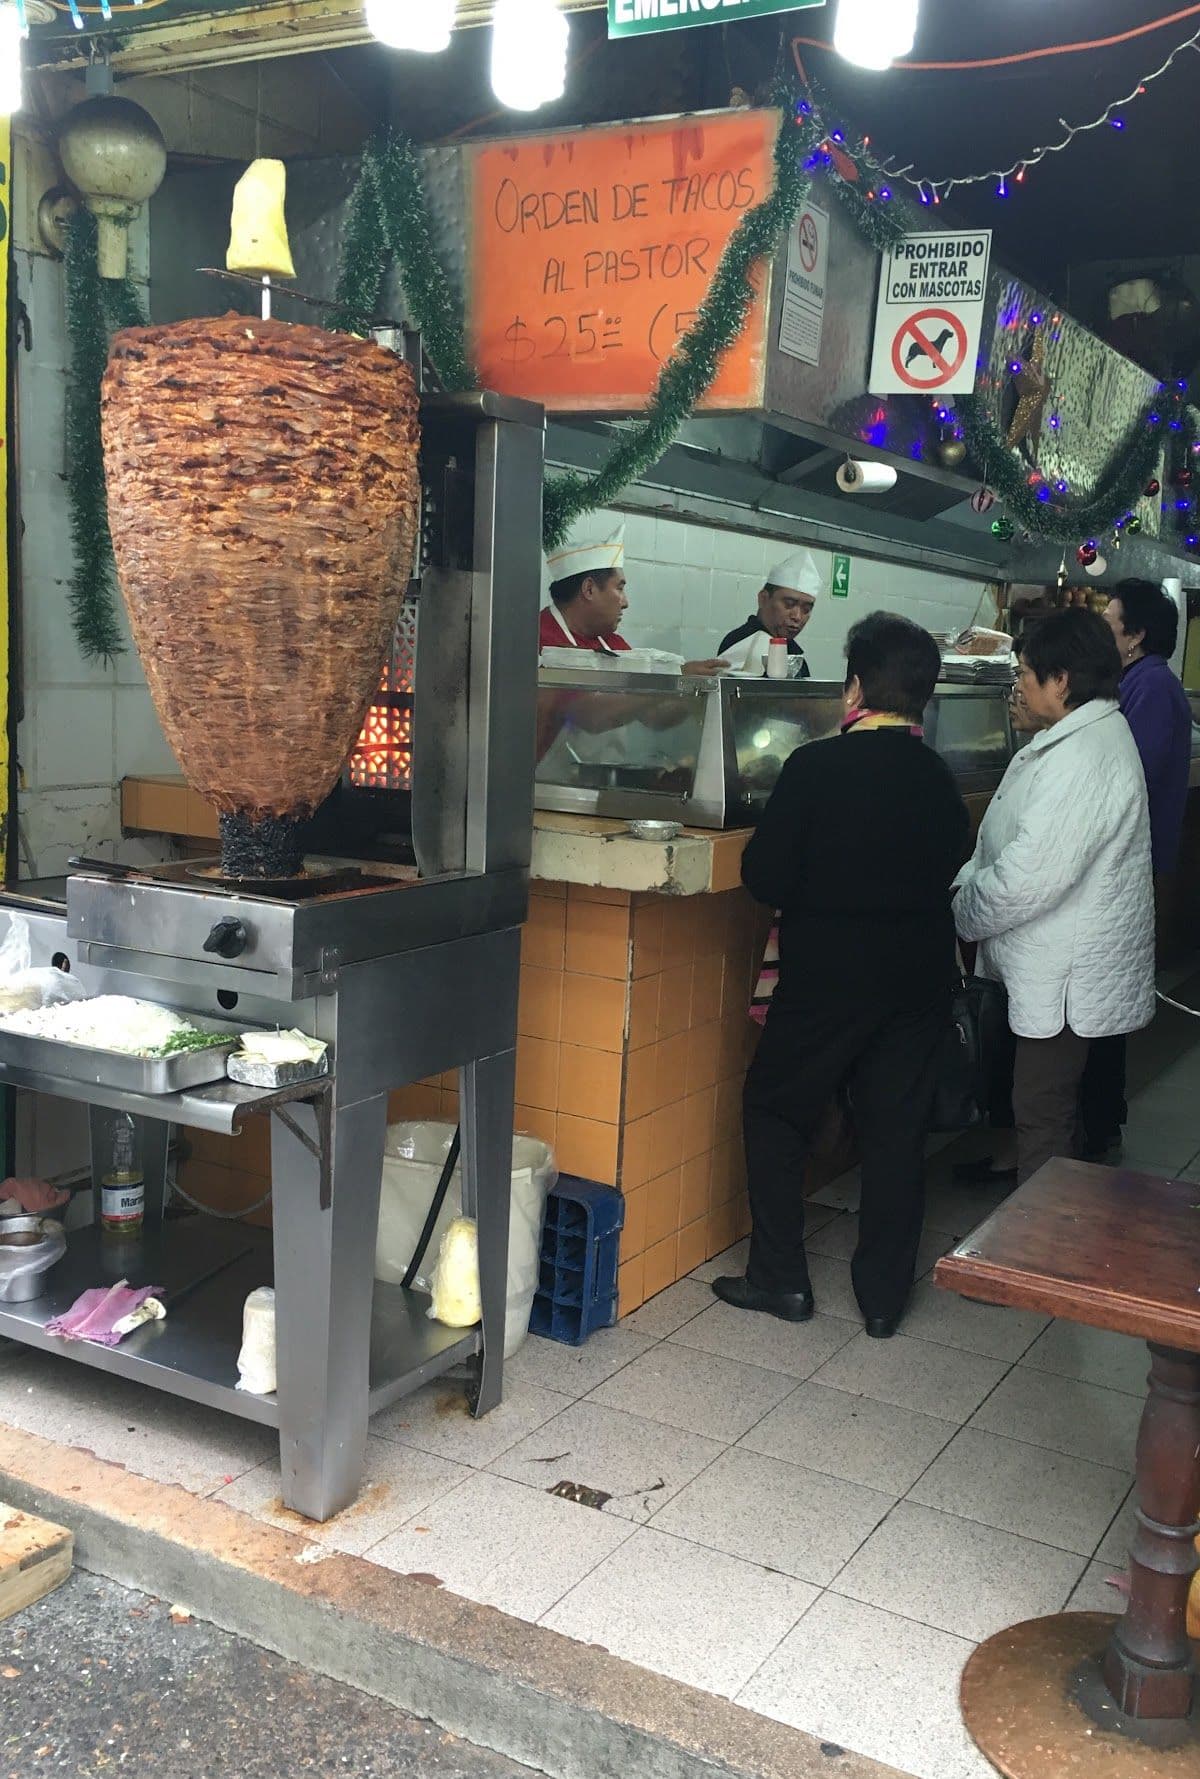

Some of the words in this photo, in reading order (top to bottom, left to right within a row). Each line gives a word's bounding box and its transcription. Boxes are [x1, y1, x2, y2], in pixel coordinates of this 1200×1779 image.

[495, 178, 599, 233] ORDEN
[612, 183, 649, 221] DE
[662, 167, 756, 215] TACOS
[894, 241, 984, 260] PROHIBIDO
[543, 257, 574, 294] AL
[585, 238, 710, 288] PASTOR
[909, 260, 968, 279] ENTRAR
[892, 282, 917, 298] CON
[919, 279, 982, 298] MASCOTAS
